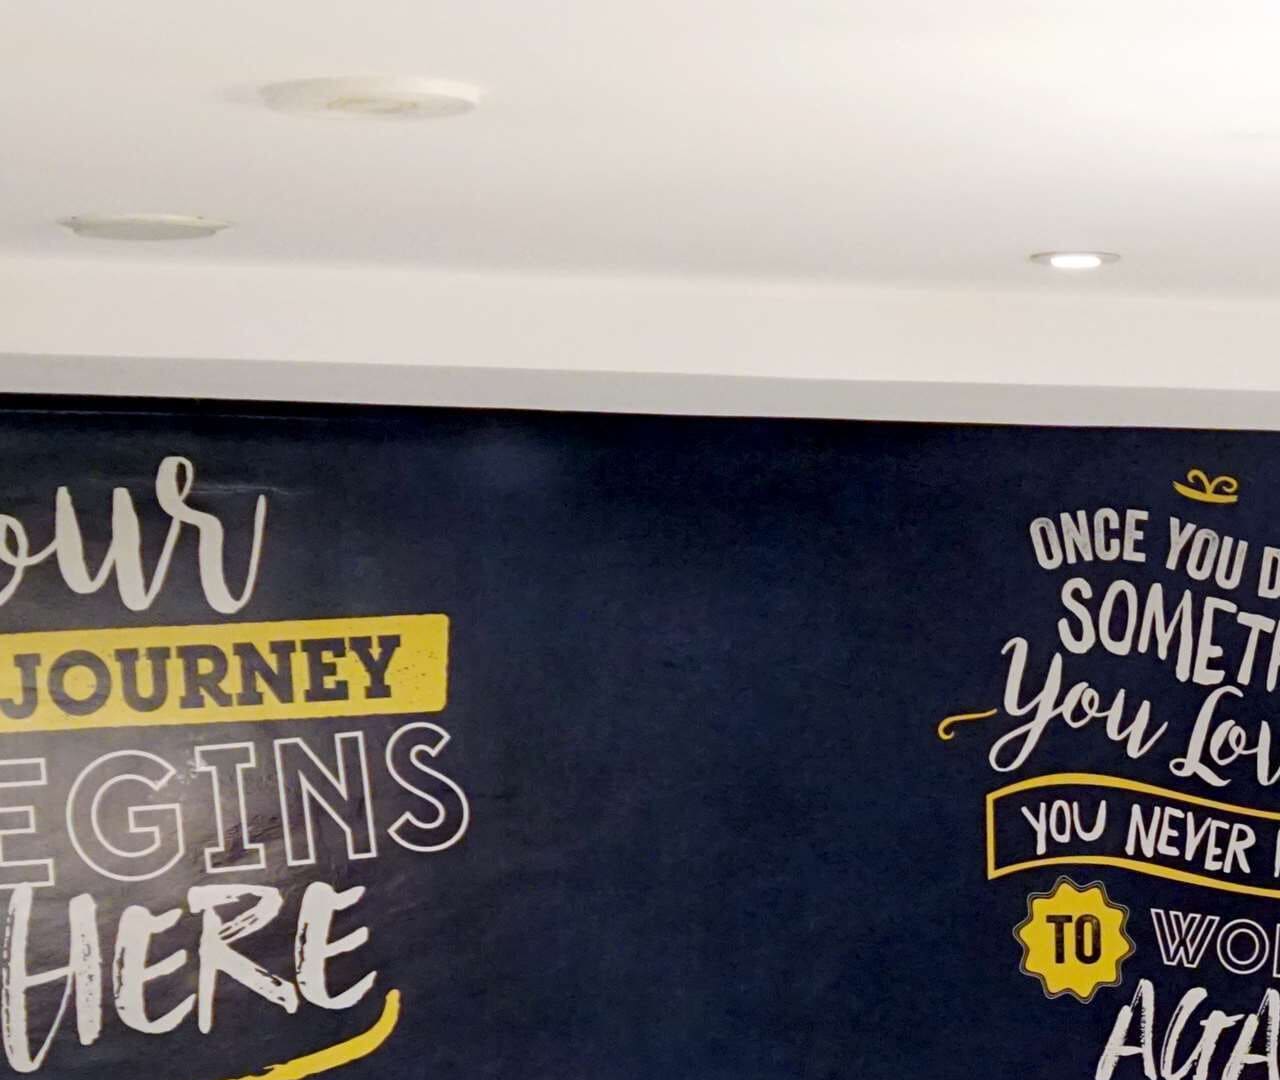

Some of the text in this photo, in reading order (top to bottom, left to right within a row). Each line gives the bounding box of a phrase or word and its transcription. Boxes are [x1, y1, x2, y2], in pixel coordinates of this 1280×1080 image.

[1030, 508, 1148, 570] ONCE
[1165, 517, 1251, 589] YOU
[0, 634, 401, 720] JOURNEY
[988, 636, 1169, 773] You
[1020, 799, 1107, 856] YOU
[1125, 803, 1257, 875] NEVER
[1, 880, 378, 1074] HERE
[1045, 913, 1100, 967] TO
